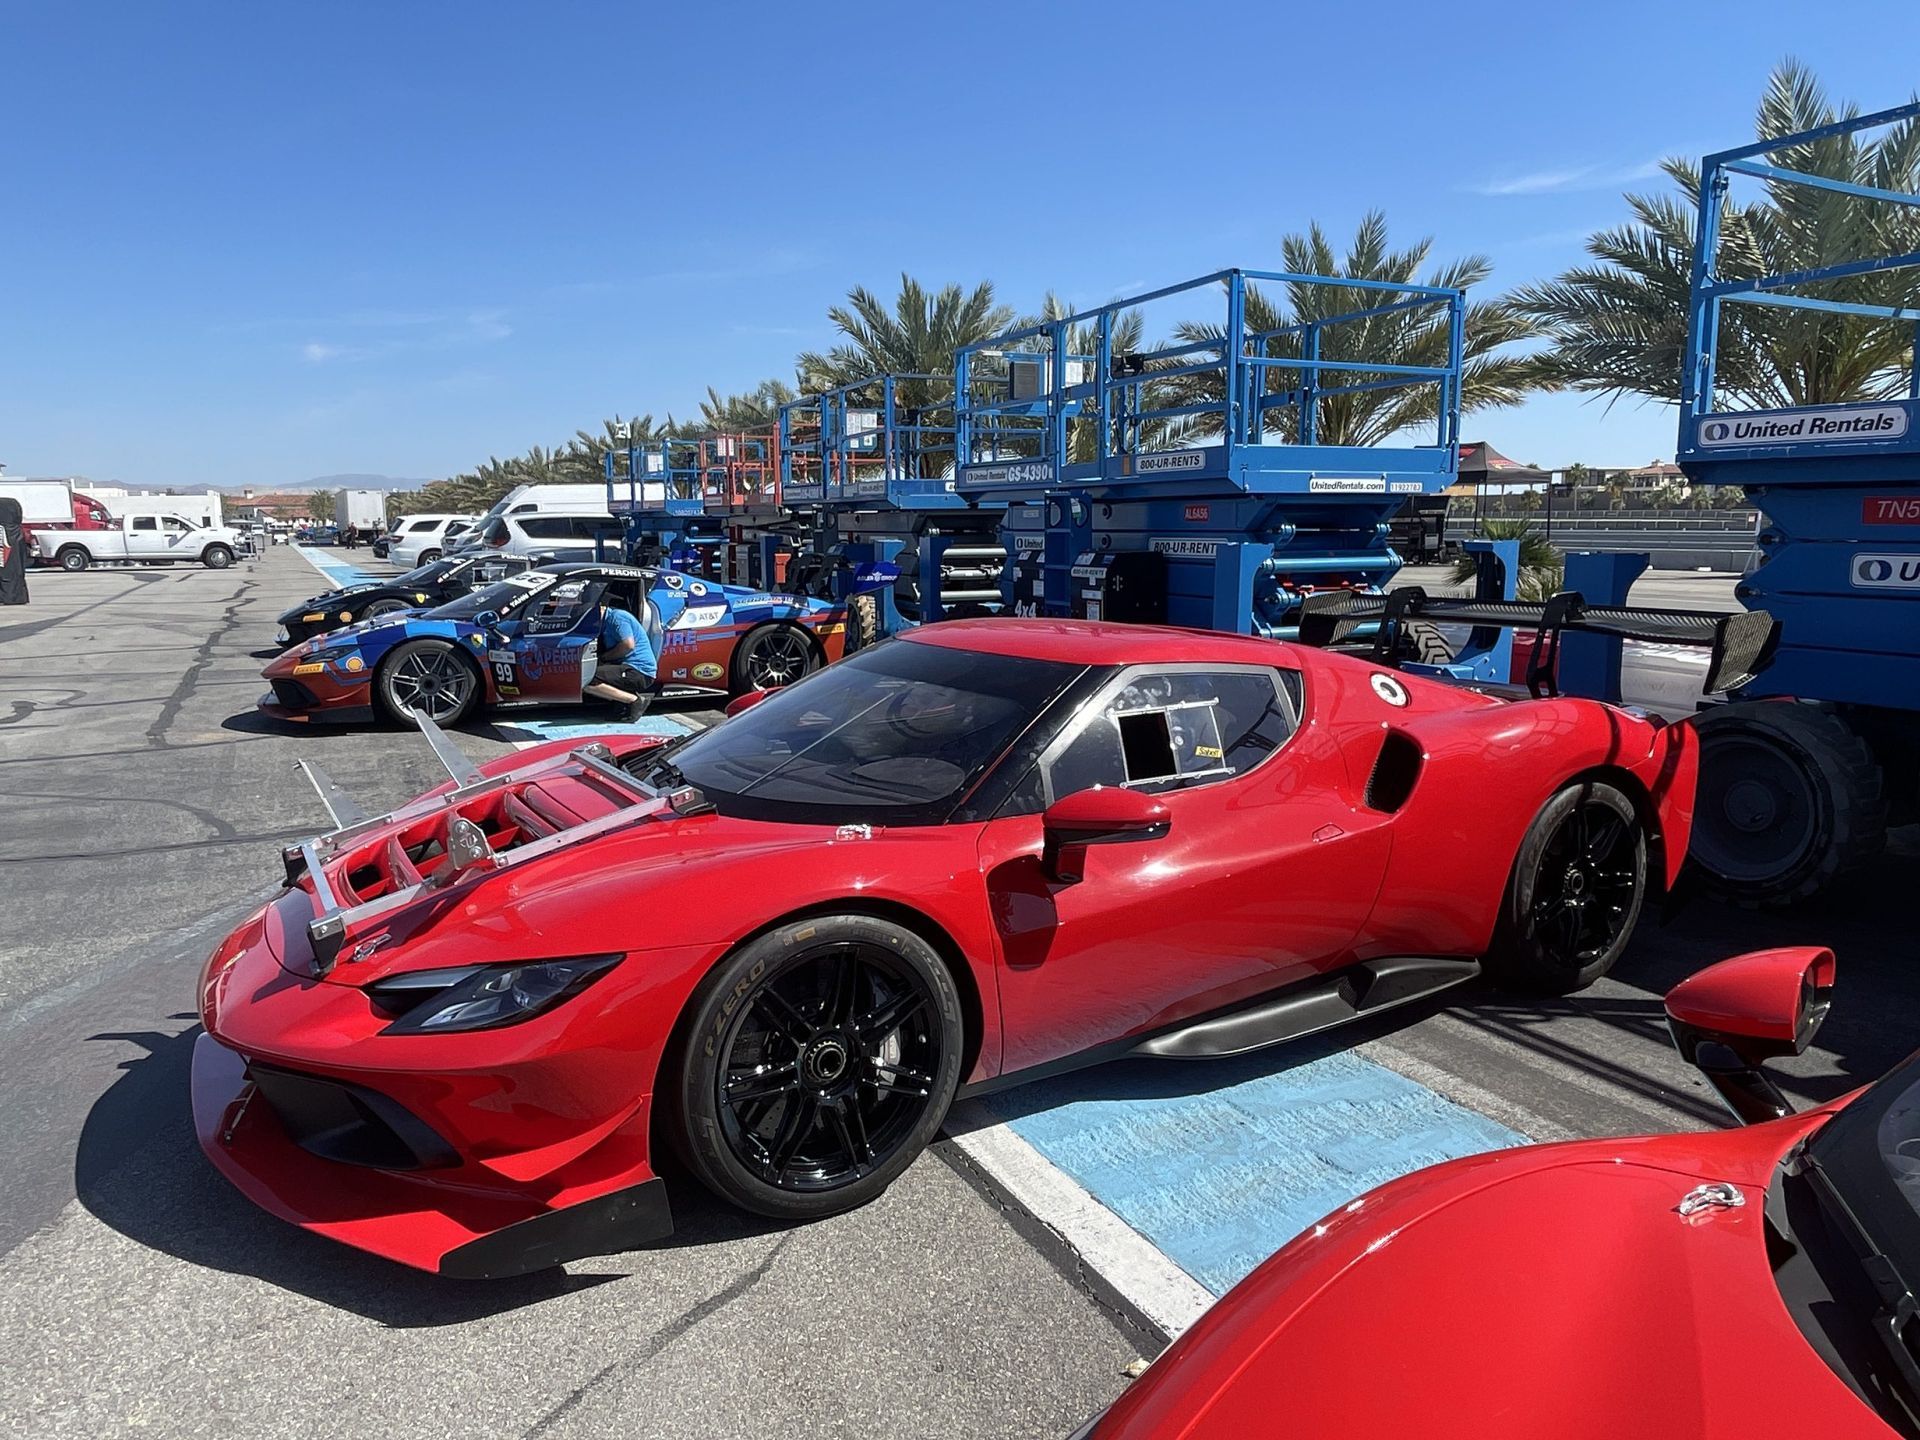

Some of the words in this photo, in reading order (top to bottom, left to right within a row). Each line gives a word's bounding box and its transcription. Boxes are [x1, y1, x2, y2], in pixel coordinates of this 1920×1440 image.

[1734, 418, 1805, 439] United
[1808, 413, 1895, 435] Rentals
[1140, 455, 1200, 470] 800-UR-RENTS
[1008, 464, 1048, 482] GS-4390
[1311, 481, 1384, 490] UnitedRentals.com
[1154, 541, 1217, 554] 800-UR-RENT
[600, 567, 642, 577] PERONI
[699, 611, 719, 621] AT&T
[1014, 599, 1037, 618] 4x4
[495, 663, 513, 682] 99
[715, 959, 765, 1036] ZERO
